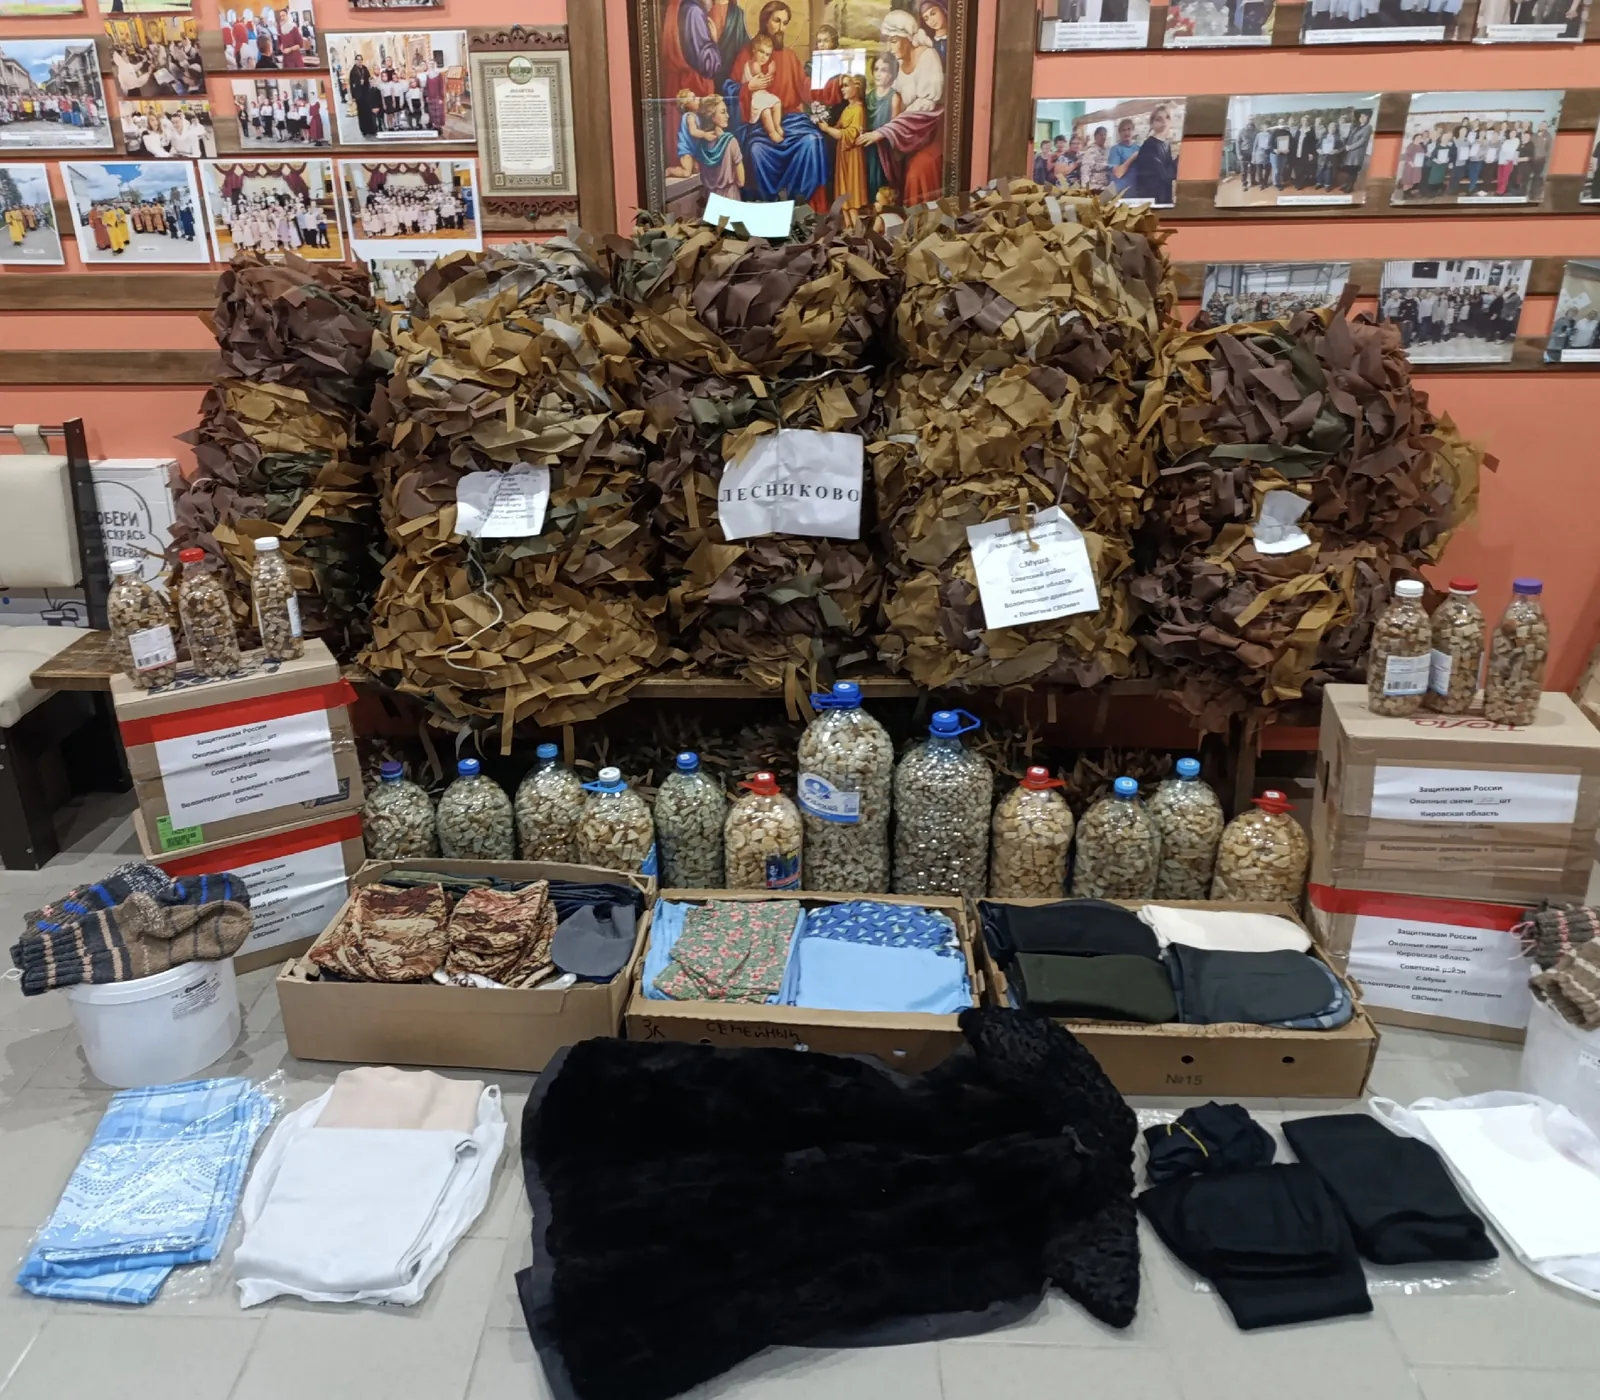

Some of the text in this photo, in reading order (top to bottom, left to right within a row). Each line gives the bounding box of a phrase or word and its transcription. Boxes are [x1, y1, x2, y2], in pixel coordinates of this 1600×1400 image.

[720, 483, 860, 502] ЛЕСНИКОВО
[243, 724, 267, 734] России
[262, 864, 286, 873] России
[1398, 928, 1447, 937] Защитникам
[1400, 963, 1440, 972] Советский
[1166, 1073, 1203, 1086] №15
